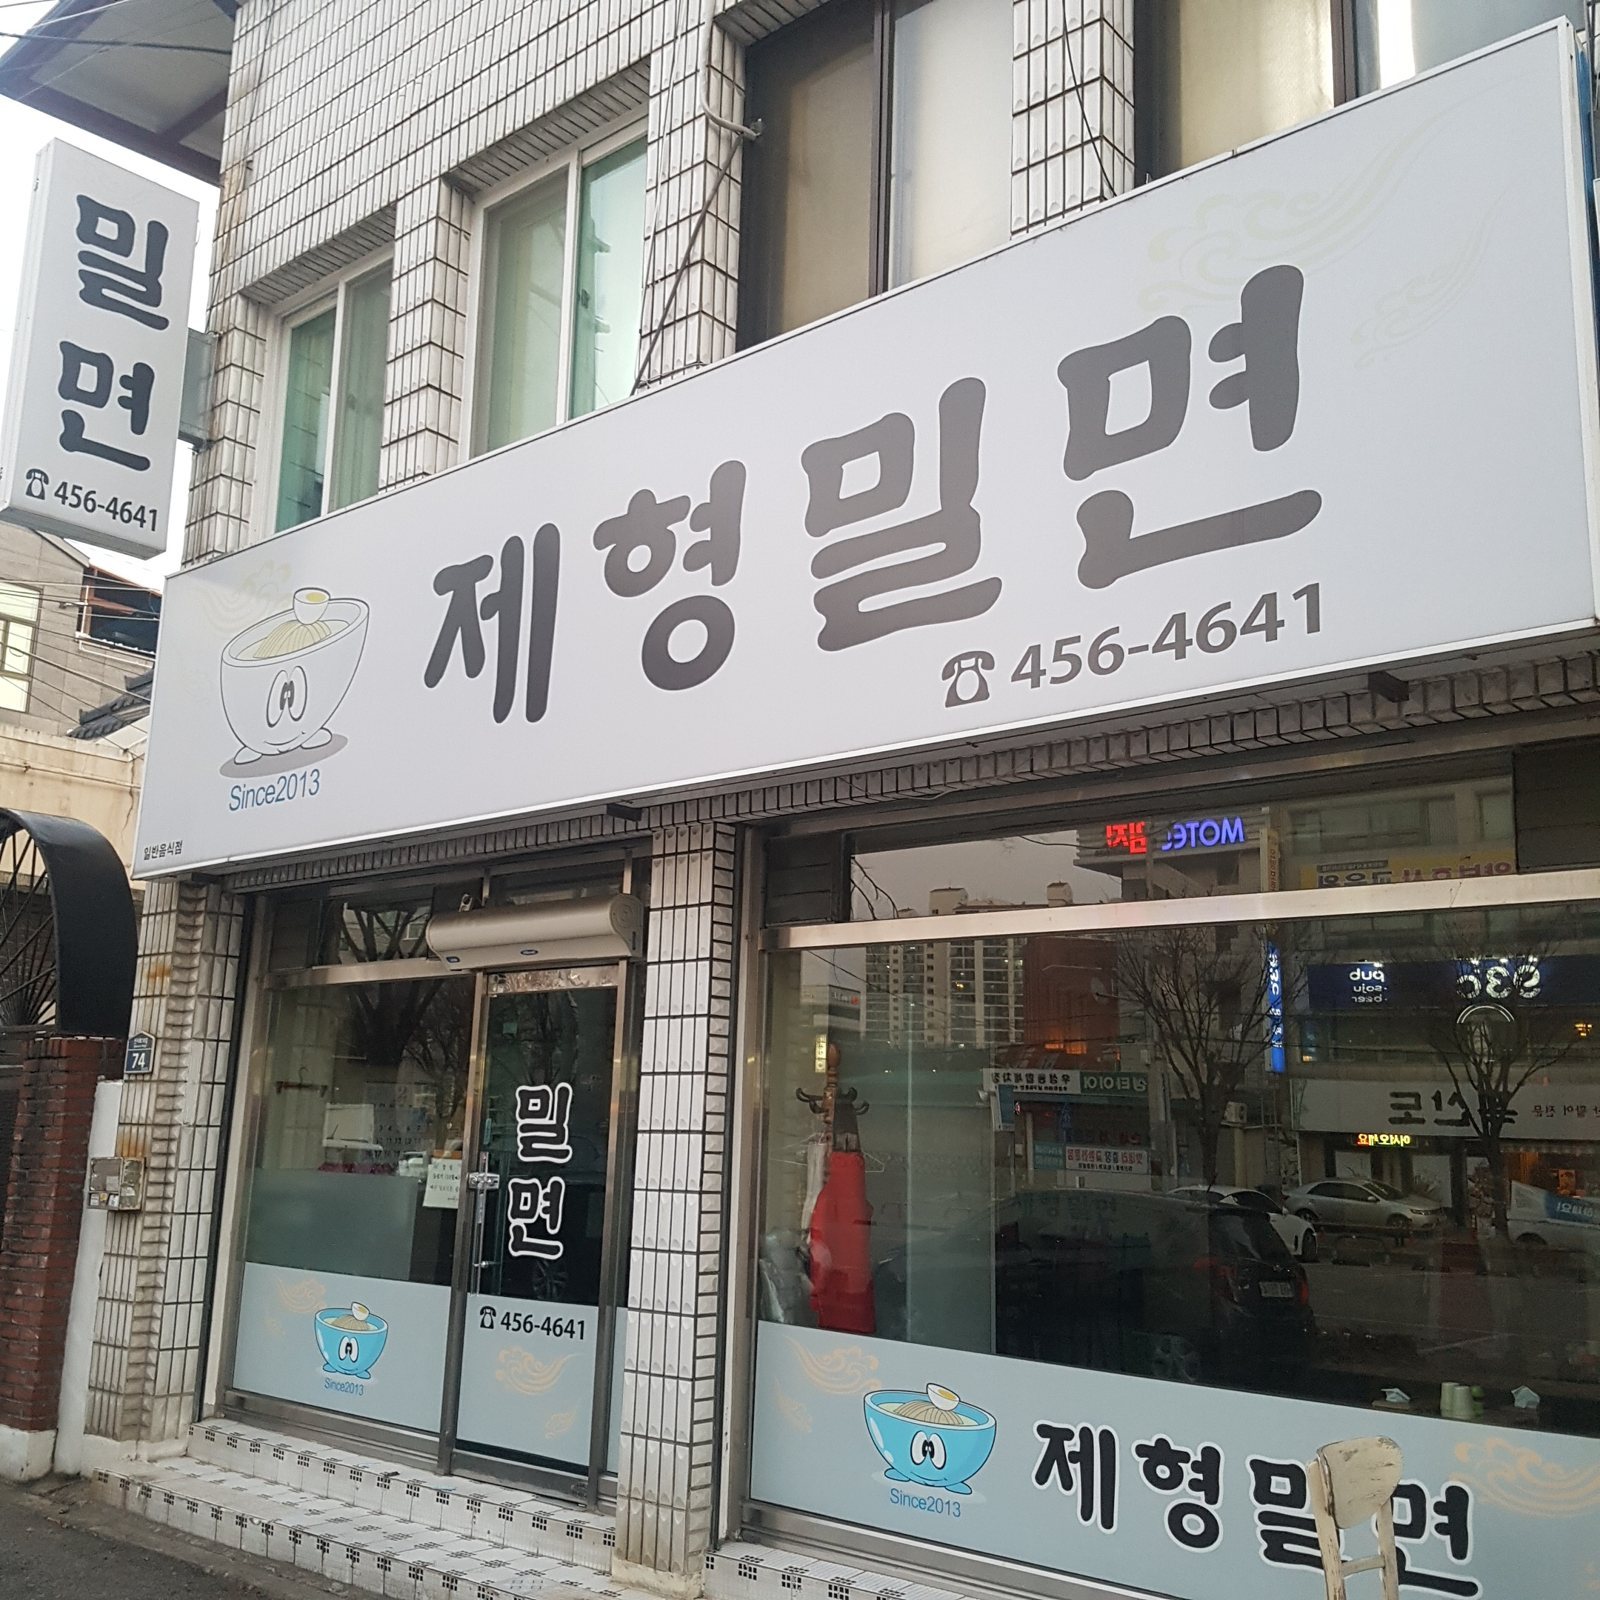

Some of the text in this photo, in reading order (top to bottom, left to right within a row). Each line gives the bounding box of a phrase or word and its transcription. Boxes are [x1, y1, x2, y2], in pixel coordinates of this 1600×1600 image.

[58, 193, 170, 472] 밀면
[53, 480, 159, 533] 456-4641
[424, 264, 1322, 725] 제형밀면
[1010, 582, 1321, 689] 456-4641
[229, 769, 320, 811] Since2013
[143, 840, 183, 861] 일반음식점
[131, 1052, 146, 1069] 74
[508, 1082, 573, 1260] 밀면
[500, 1311, 586, 1341] 456-4641
[324, 1377, 364, 1396] Since2013
[890, 1488, 961, 1517] Since2013
